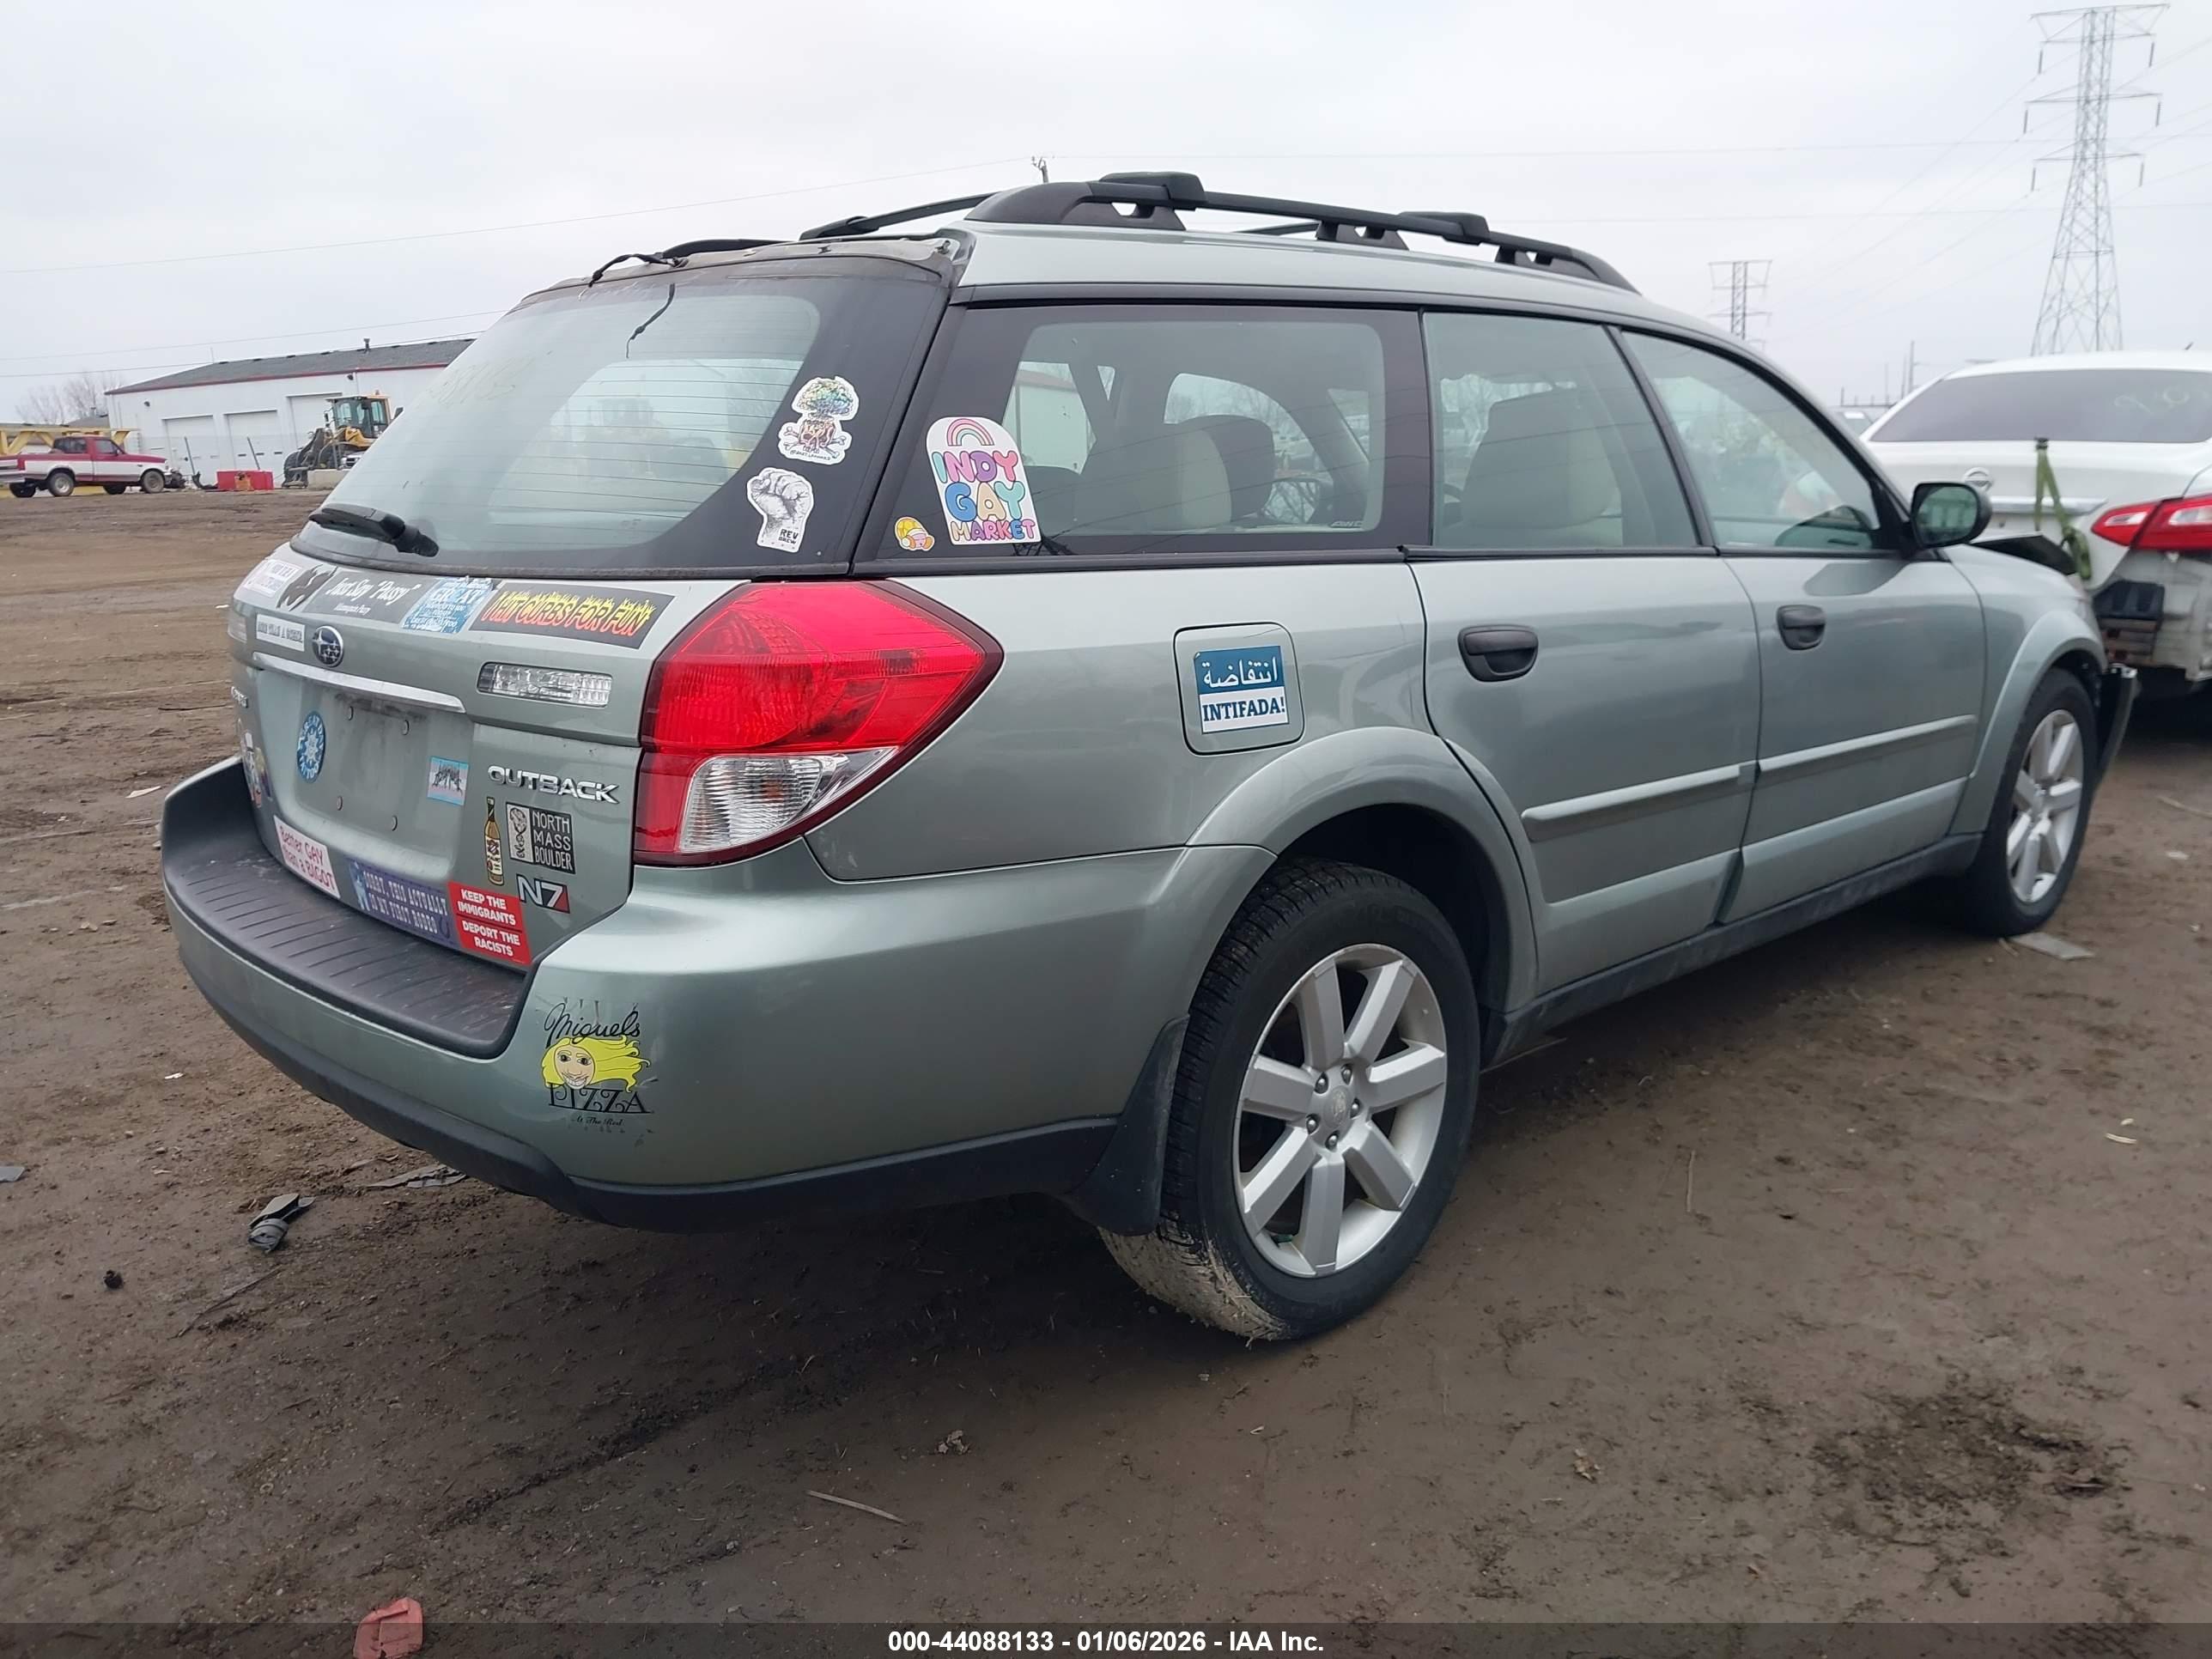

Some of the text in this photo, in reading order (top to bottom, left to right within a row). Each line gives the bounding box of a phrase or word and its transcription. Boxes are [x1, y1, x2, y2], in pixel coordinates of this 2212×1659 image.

[932, 451, 1018, 483] INDY
[945, 481, 1025, 522] GAY
[780, 529, 799, 539] REV
[951, 519, 1036, 541] MARKET
[492, 590, 529, 623] HIT
[516, 591, 580, 627] CURBS
[564, 594, 614, 631] FOR
[600, 598, 656, 636] FUN
[1202, 657, 1278, 688] انتفاضة
[1202, 696, 1285, 721] INTIFADA!
[488, 766, 620, 804] OUTBACK
[532, 810, 570, 834] NORTH
[533, 830, 571, 851] MASS
[305, 842, 324, 866] GAY
[534, 846, 573, 871] BOULDER
[408, 887, 447, 916] ACTUALLY
[461, 889, 507, 909] KEEP THE
[516, 873, 564, 909] N7
[458, 901, 516, 925] IMMIGRANTS
[462, 920, 520, 945] DEPORT THE
[474, 936, 514, 957] RACISTS
[548, 1084, 653, 1114] PIZZA
